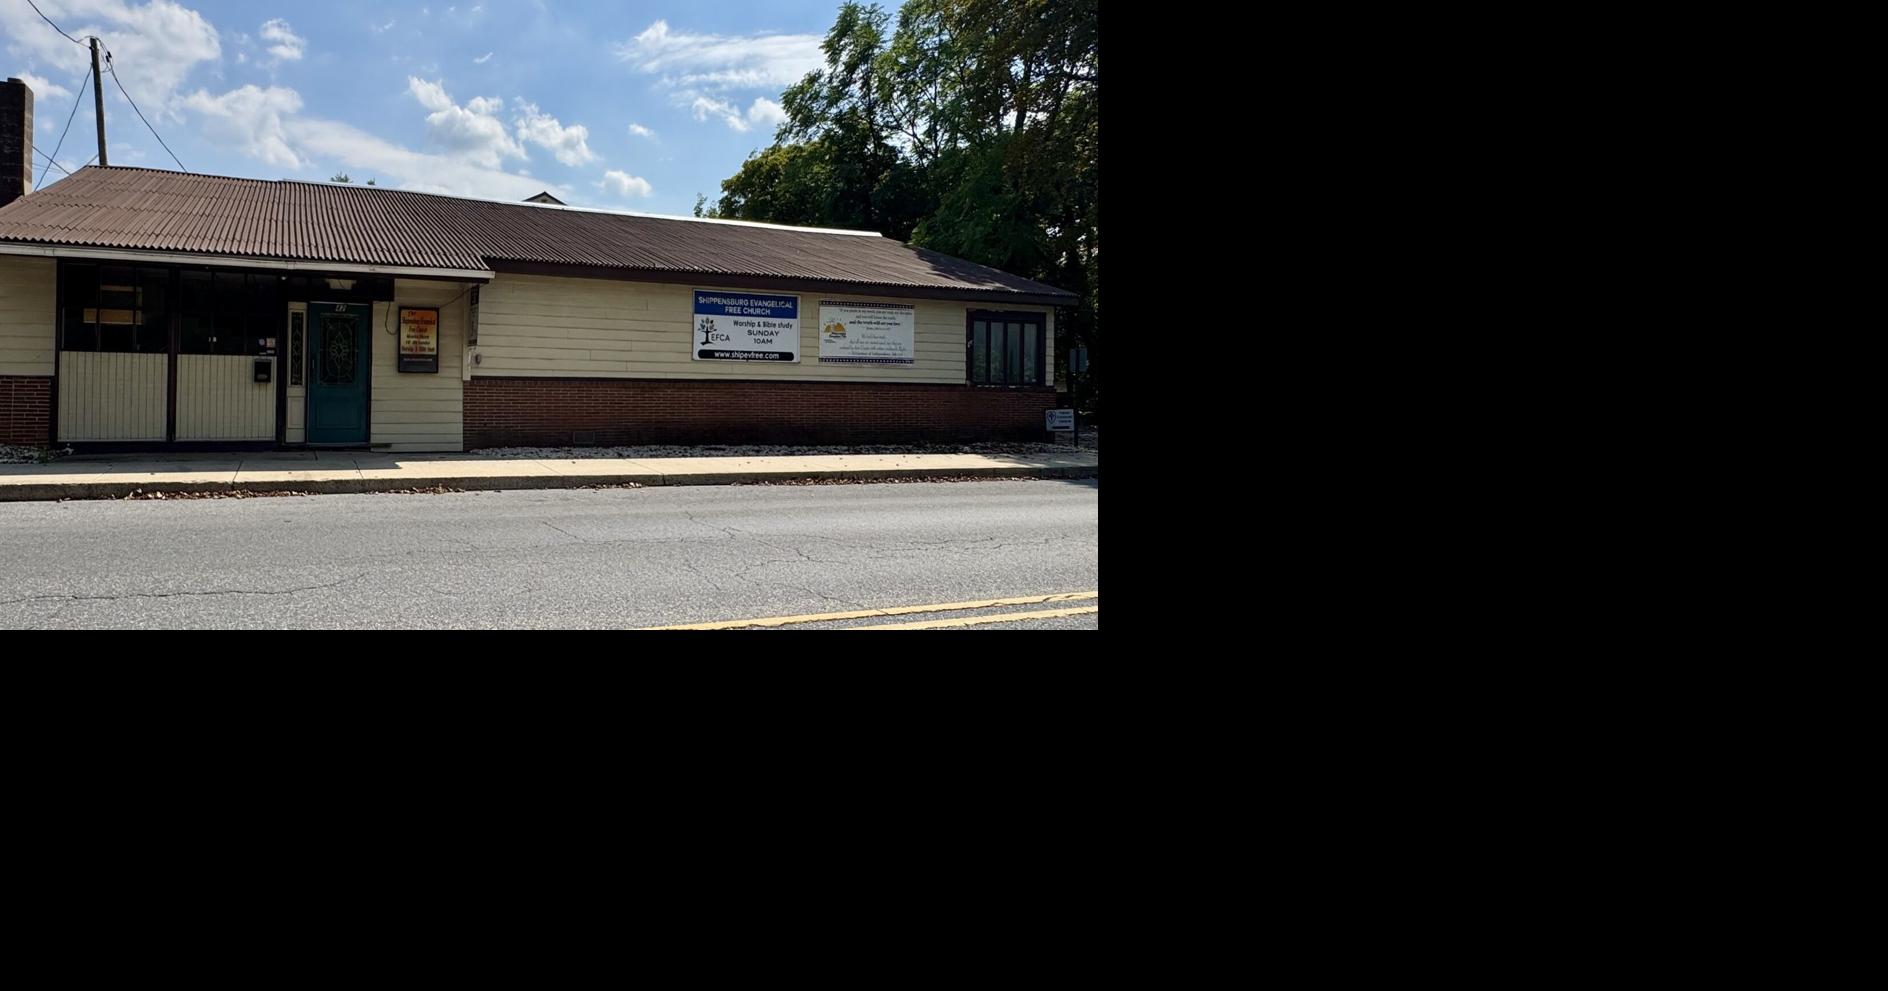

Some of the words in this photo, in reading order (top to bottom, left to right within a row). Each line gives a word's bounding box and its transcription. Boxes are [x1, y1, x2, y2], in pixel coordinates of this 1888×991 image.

[698, 296, 749, 306] SHIPPENSBURG
[750, 299, 792, 308] EVANGELICAL
[742, 307, 770, 315] CHURCH
[733, 319, 756, 328] Worship
[763, 320, 776, 328] Bible
[777, 321, 792, 330] study
[711, 333, 730, 342] EFCA
[747, 329, 779, 337] SUNDAY
[714, 351, 779, 360] www.shipevfree.com
